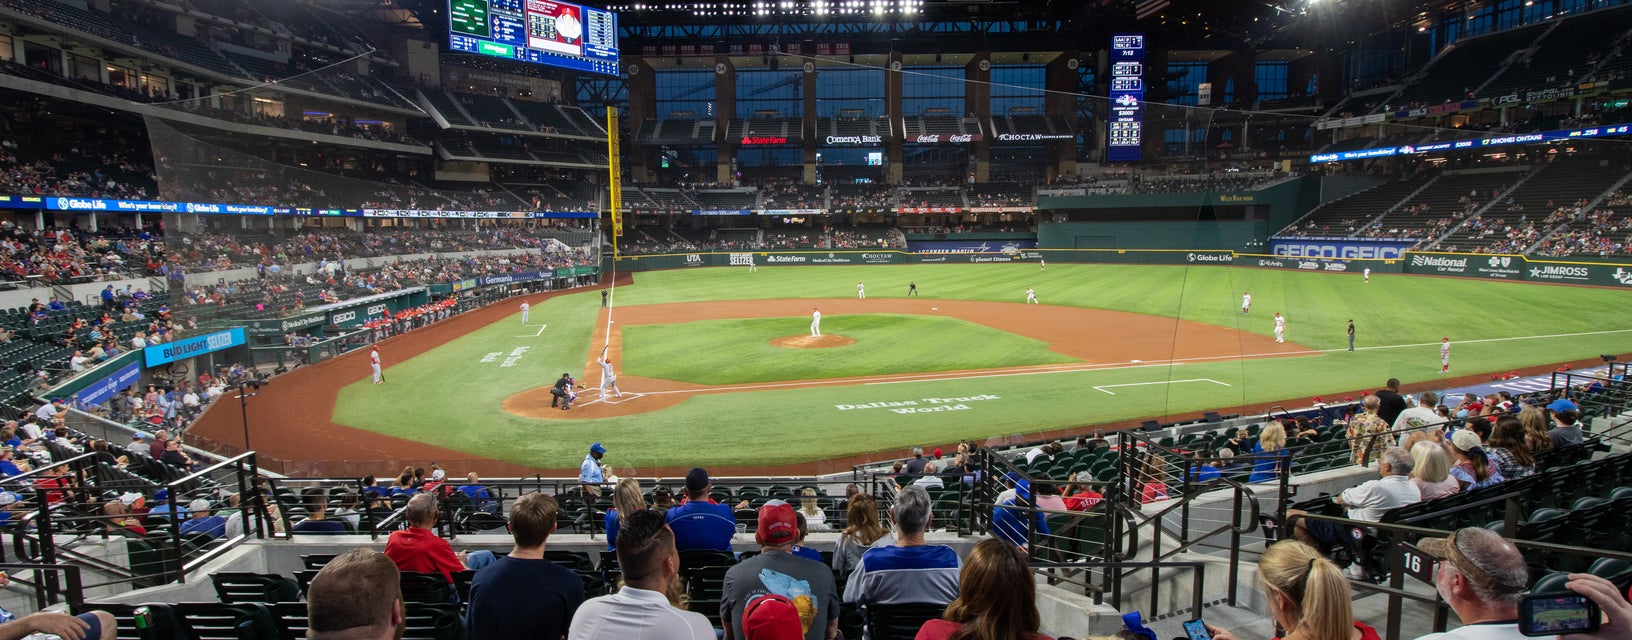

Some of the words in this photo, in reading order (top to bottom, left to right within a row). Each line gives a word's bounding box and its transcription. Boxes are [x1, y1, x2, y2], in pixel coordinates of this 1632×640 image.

[1499, 94, 1521, 104] PGL
[1408, 108, 1427, 117] 105.3
[862, 135, 882, 143] Bank
[1490, 136, 1515, 145] SHOHEI
[1516, 134, 1543, 142] OHTANI
[69, 199, 92, 209] Globe
[93, 199, 107, 210] Life
[118, 201, 135, 209] Who's
[136, 203, 147, 211] your
[193, 203, 209, 212] Globe
[209, 204, 219, 213] Life
[686, 254, 701, 262] UTA
[1273, 244, 1337, 262] GEICO
[730, 256, 754, 265] SELTZER
[1423, 255, 1466, 267] National
[485, 275, 513, 285] Germania
[333, 311, 355, 324] GEICO
[163, 346, 182, 358] BUD
[184, 340, 207, 354] LIGHT
[207, 332, 232, 350] SELTZER
[834, 400, 918, 411] Dallas
[921, 394, 1002, 404] Truck
[888, 404, 973, 414] World
[1404, 552, 1421, 573] 16
